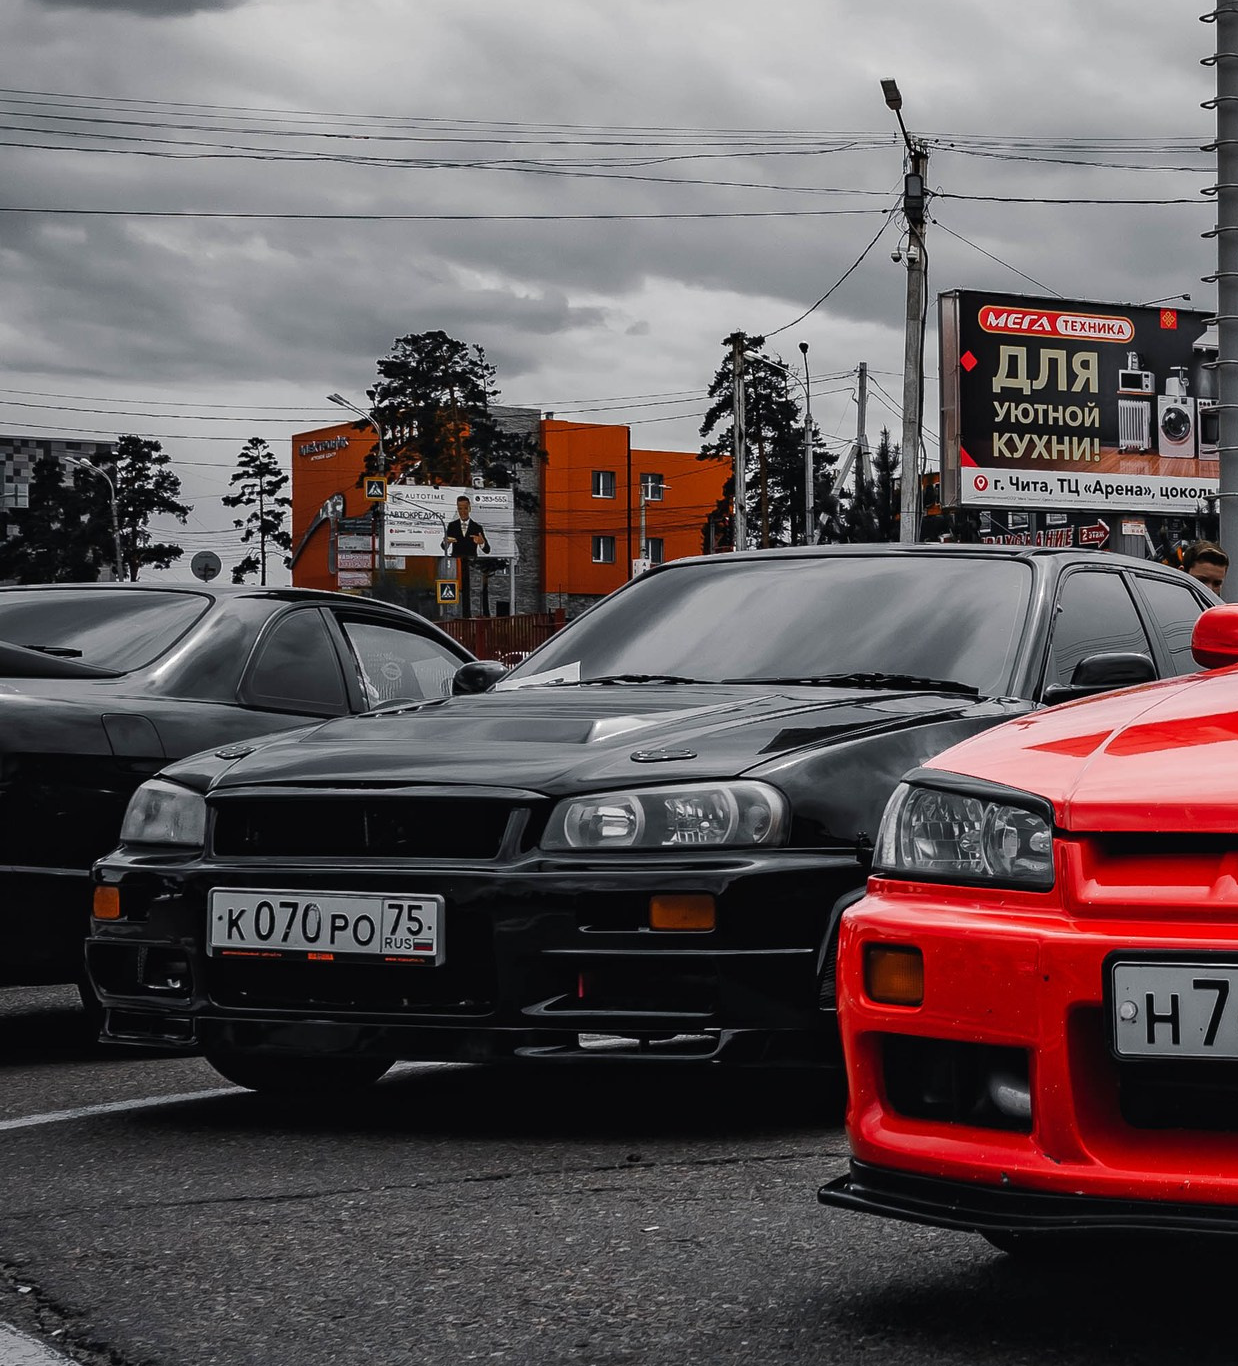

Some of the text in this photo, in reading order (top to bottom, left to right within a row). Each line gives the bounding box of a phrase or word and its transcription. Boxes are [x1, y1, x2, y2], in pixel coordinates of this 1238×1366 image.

[987, 311, 1126, 336] МЕГА ТЕХНИКА
[992, 345, 1099, 395] ДЛЯ
[993, 401, 1100, 428] УЮТНОЙ
[992, 432, 1101, 462] КУХНИ!
[994, 479, 1004, 491] г.
[1009, 476, 1053, 496] Чита,
[1057, 478, 1080, 496] ТЦ
[1084, 480, 1155, 499] «Арена»,
[227, 900, 423, 946] К070РО 75
[384, 937, 412, 950] RUS
